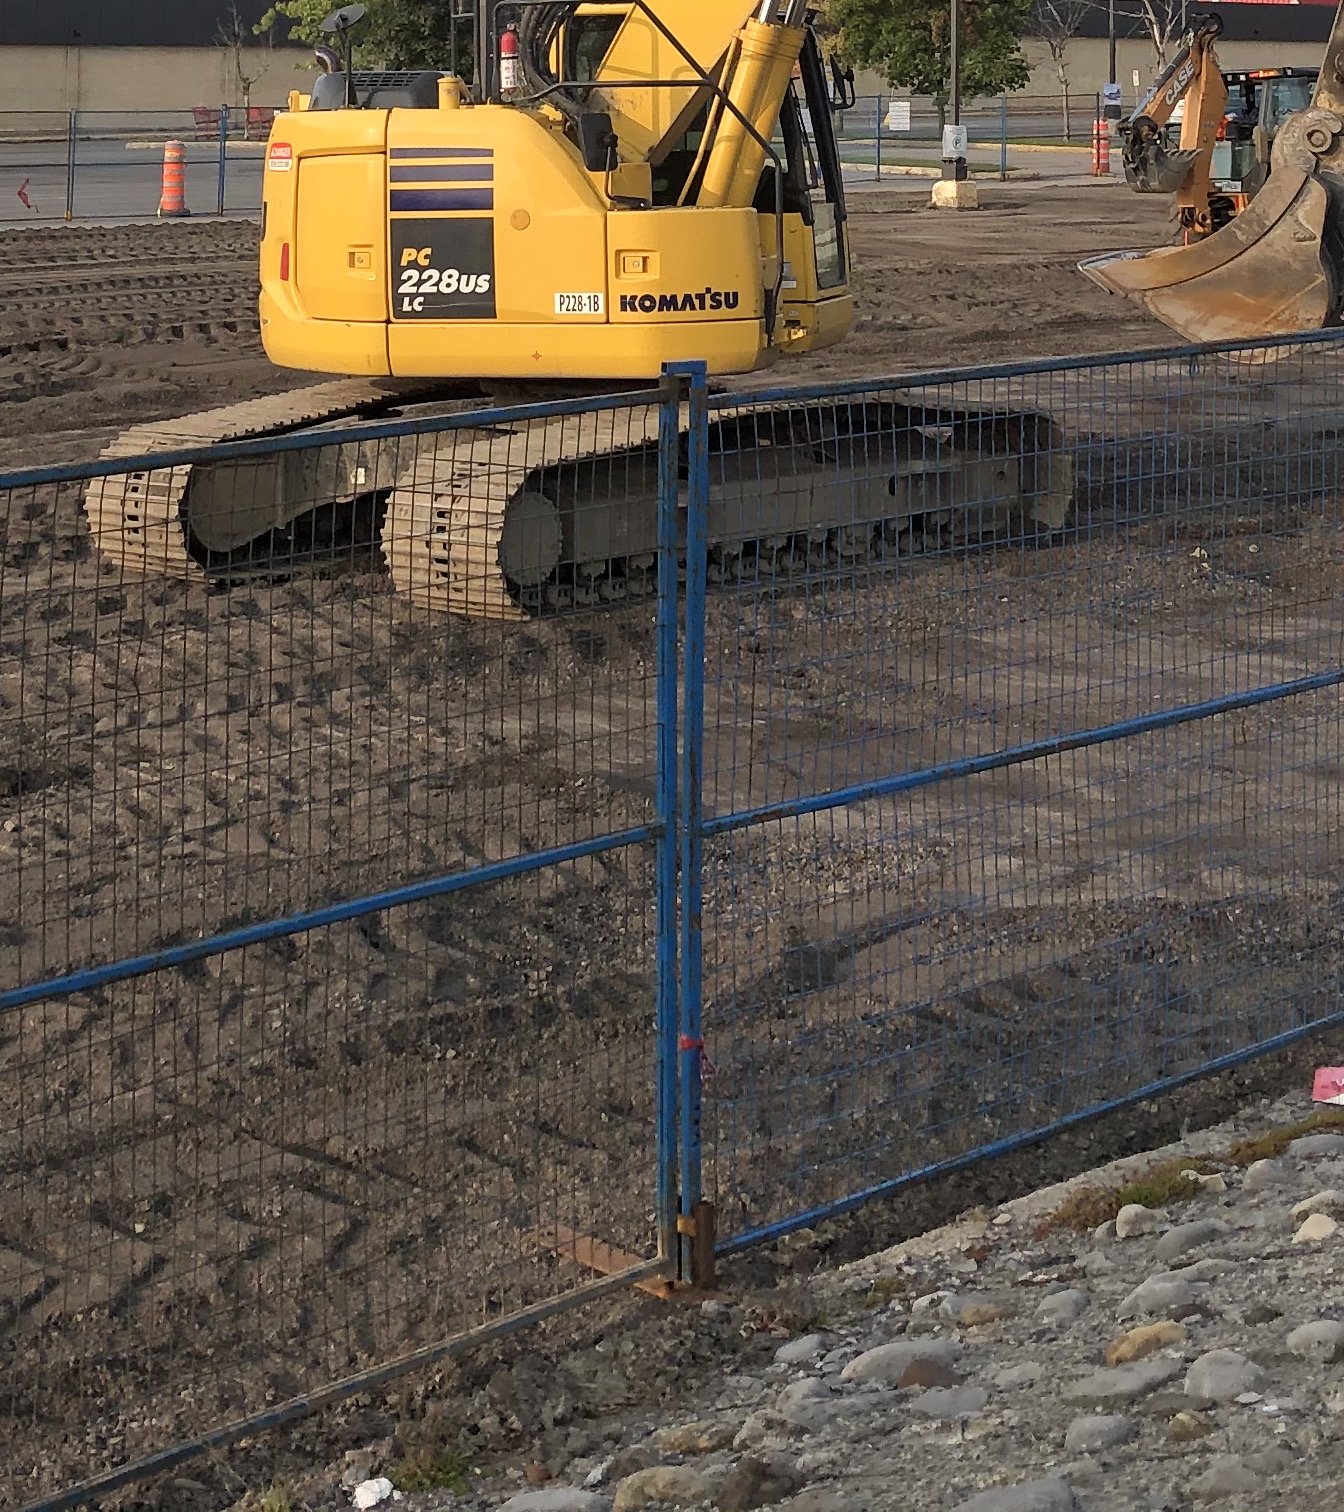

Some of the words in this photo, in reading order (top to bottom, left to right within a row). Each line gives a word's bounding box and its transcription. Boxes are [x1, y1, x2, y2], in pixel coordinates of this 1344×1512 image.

[1165, 58, 1195, 106] CASE
[400, 248, 432, 267] PC
[397, 268, 491, 294] 228US
[402, 296, 425, 312] LC
[559, 294, 600, 313] P228-1B
[619, 287, 739, 314] KOMATSU
